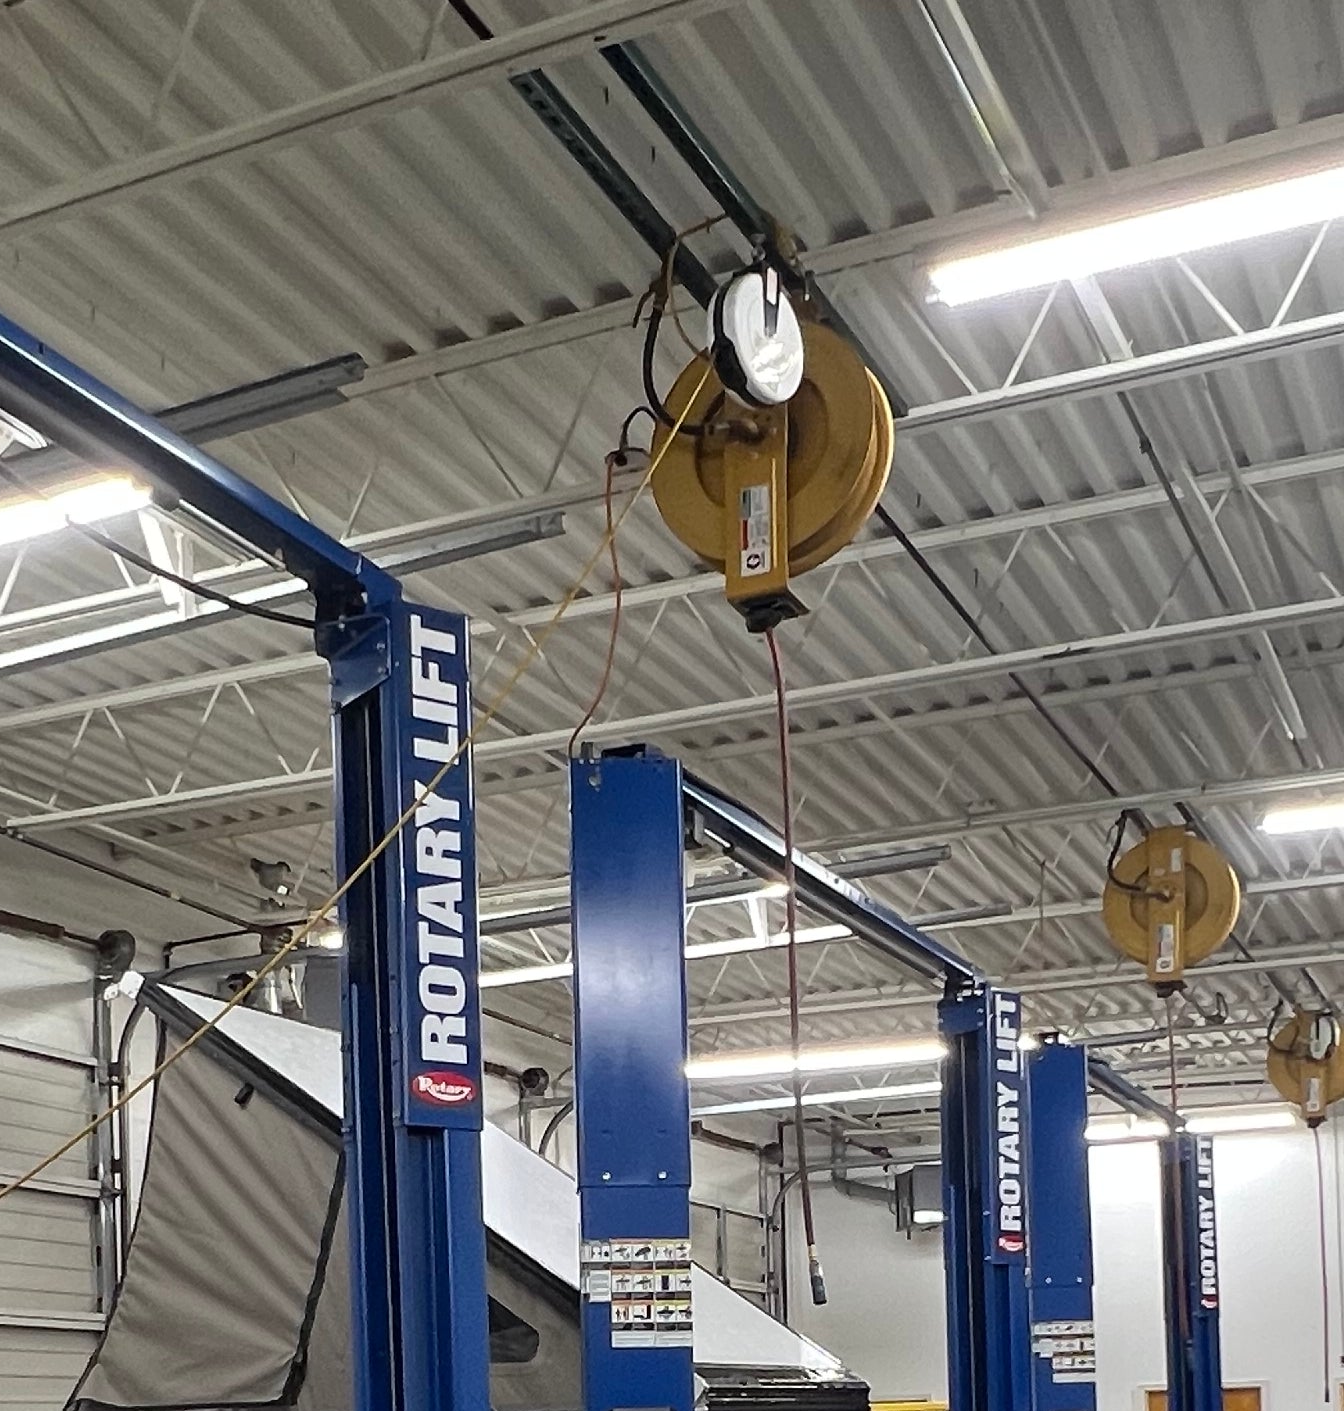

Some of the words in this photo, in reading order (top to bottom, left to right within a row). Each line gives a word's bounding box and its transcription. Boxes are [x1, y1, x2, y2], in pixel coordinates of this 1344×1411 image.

[410, 614, 460, 766] LIFT
[414, 779, 468, 1066] ROTARY
[994, 993, 1020, 1074] LIFT
[997, 1081, 1025, 1232] ROTARY
[1196, 1136, 1214, 1190] LIFT
[1198, 1194, 1216, 1295] ROTARY
